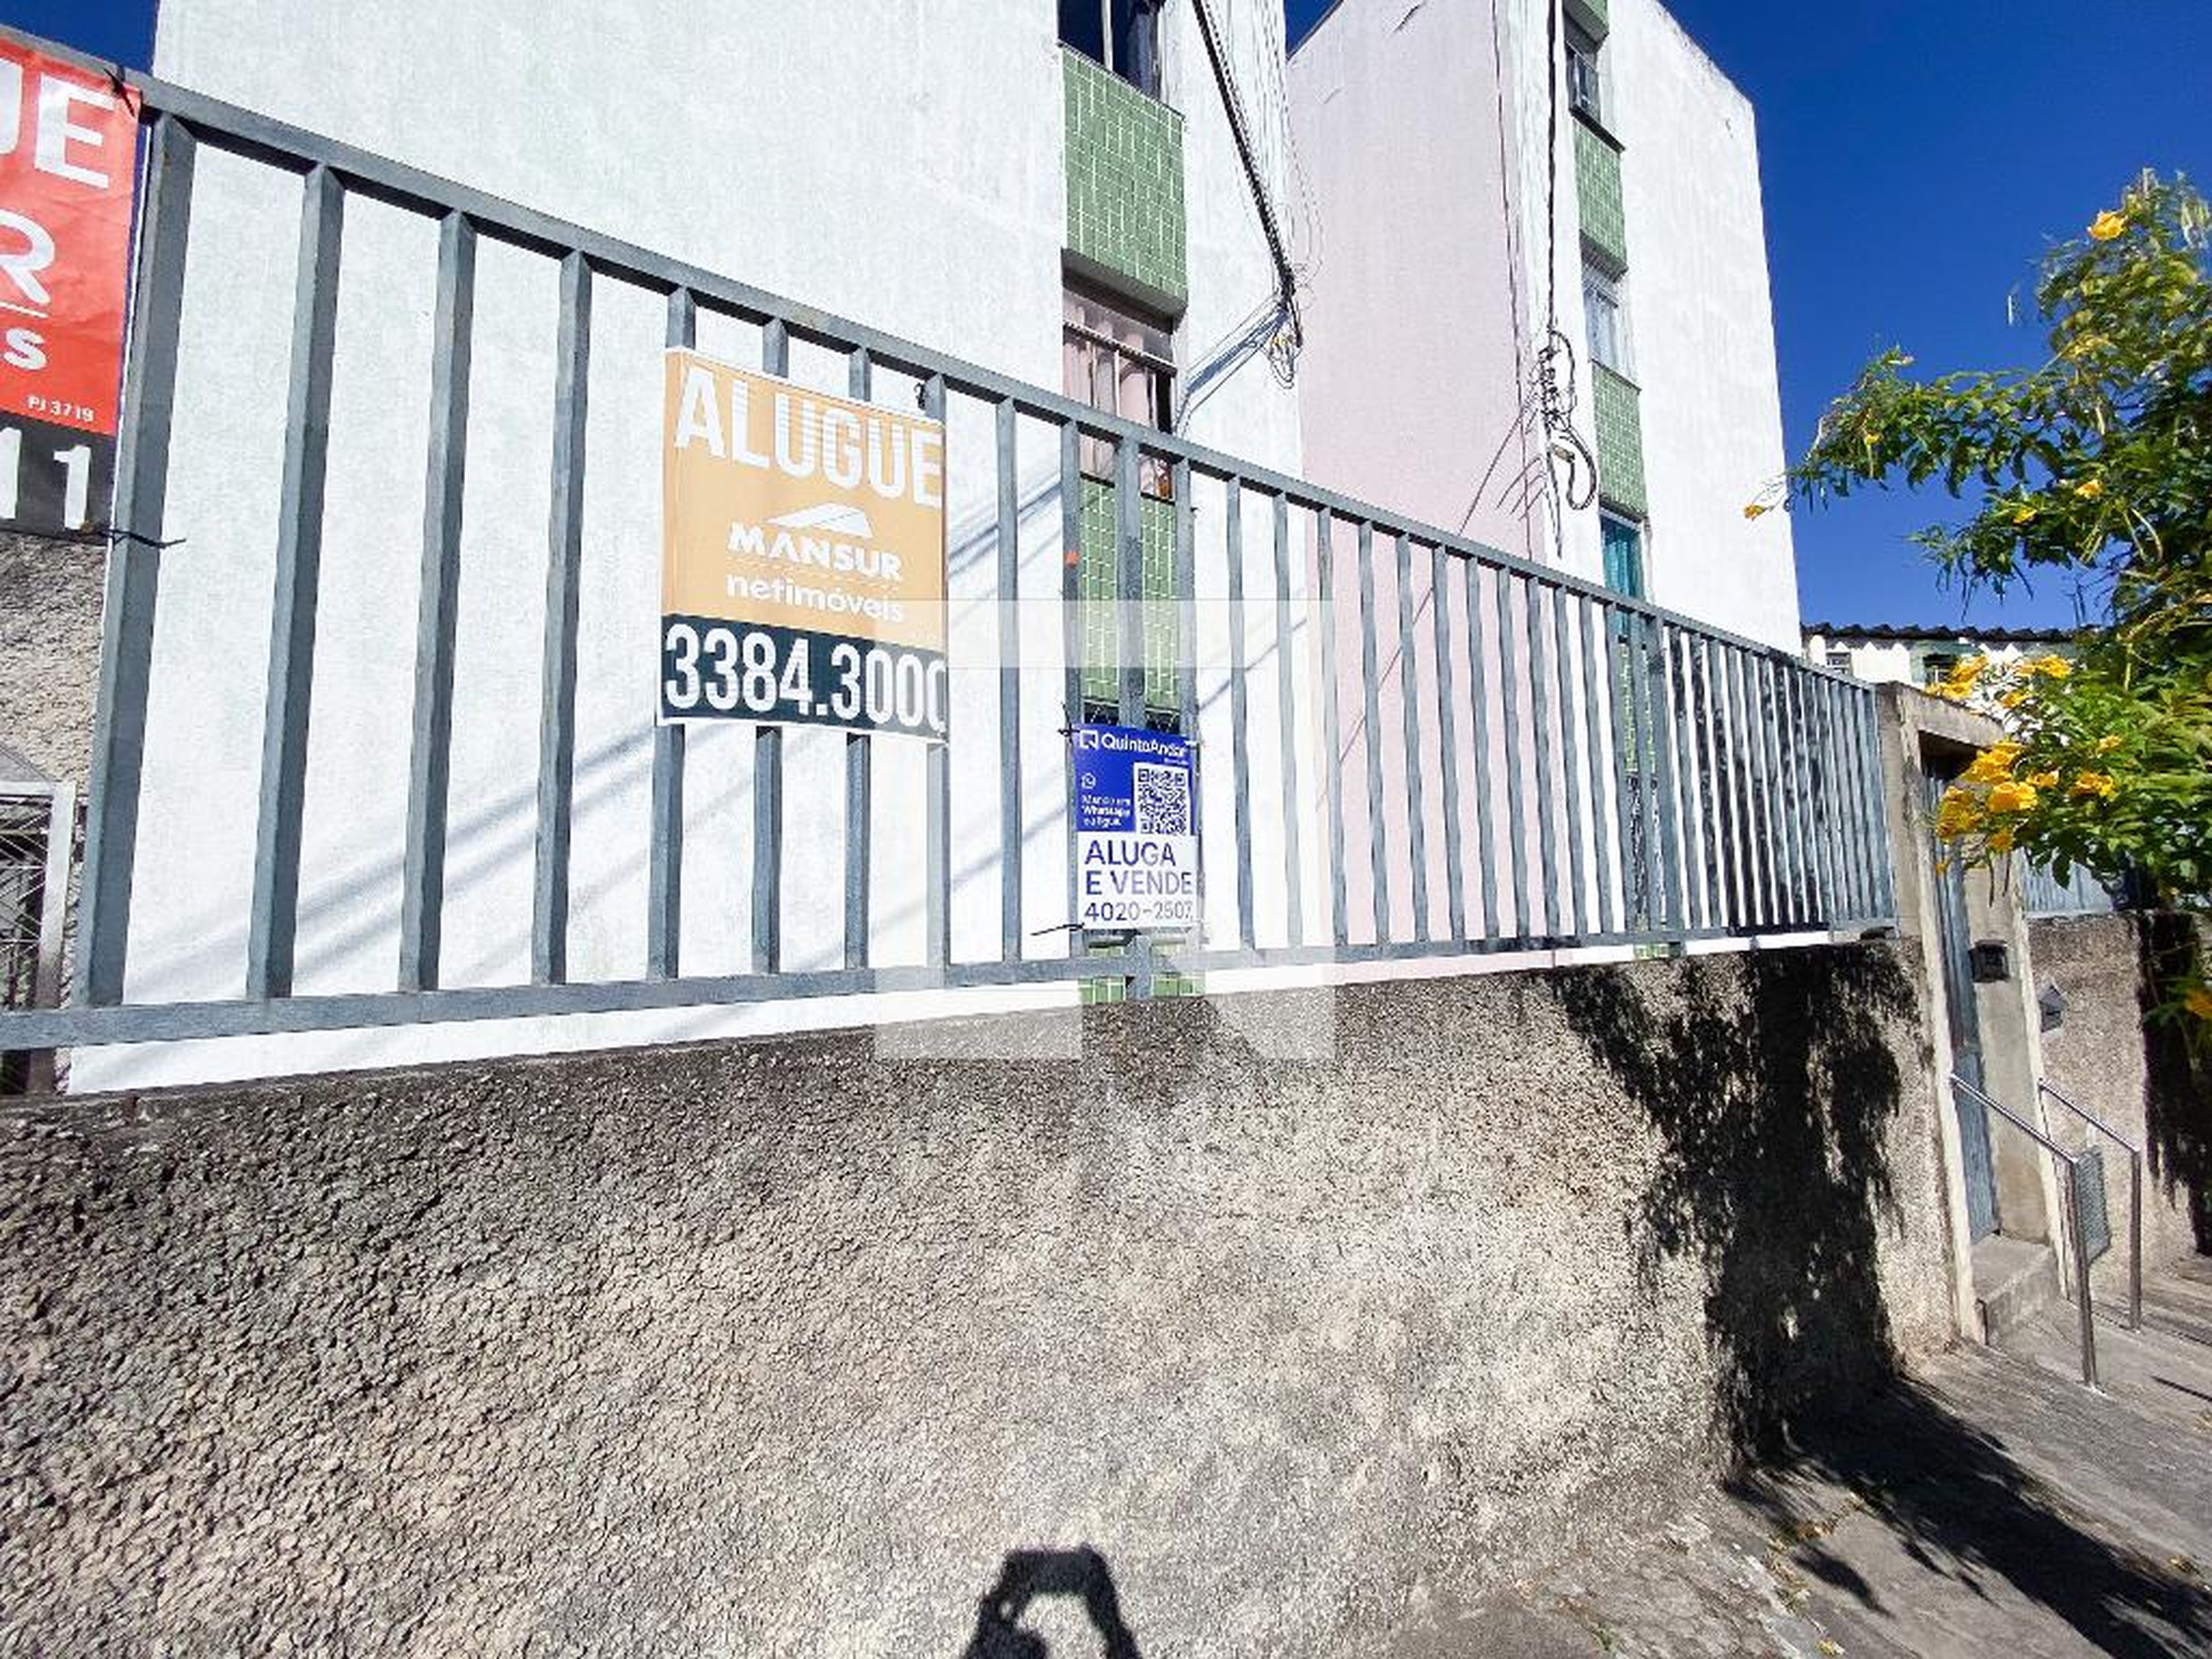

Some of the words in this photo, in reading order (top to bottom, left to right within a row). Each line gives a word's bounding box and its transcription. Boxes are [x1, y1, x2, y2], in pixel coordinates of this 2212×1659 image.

[0, 60, 114, 190] E
[674, 365, 943, 509] ALUGUE
[727, 521, 903, 582] MANSUR
[726, 574, 903, 623] netimóveis
[1085, 840, 1176, 866] ALUGA
[1086, 870, 1102, 895] E
[1109, 870, 1193, 895] VENDE
